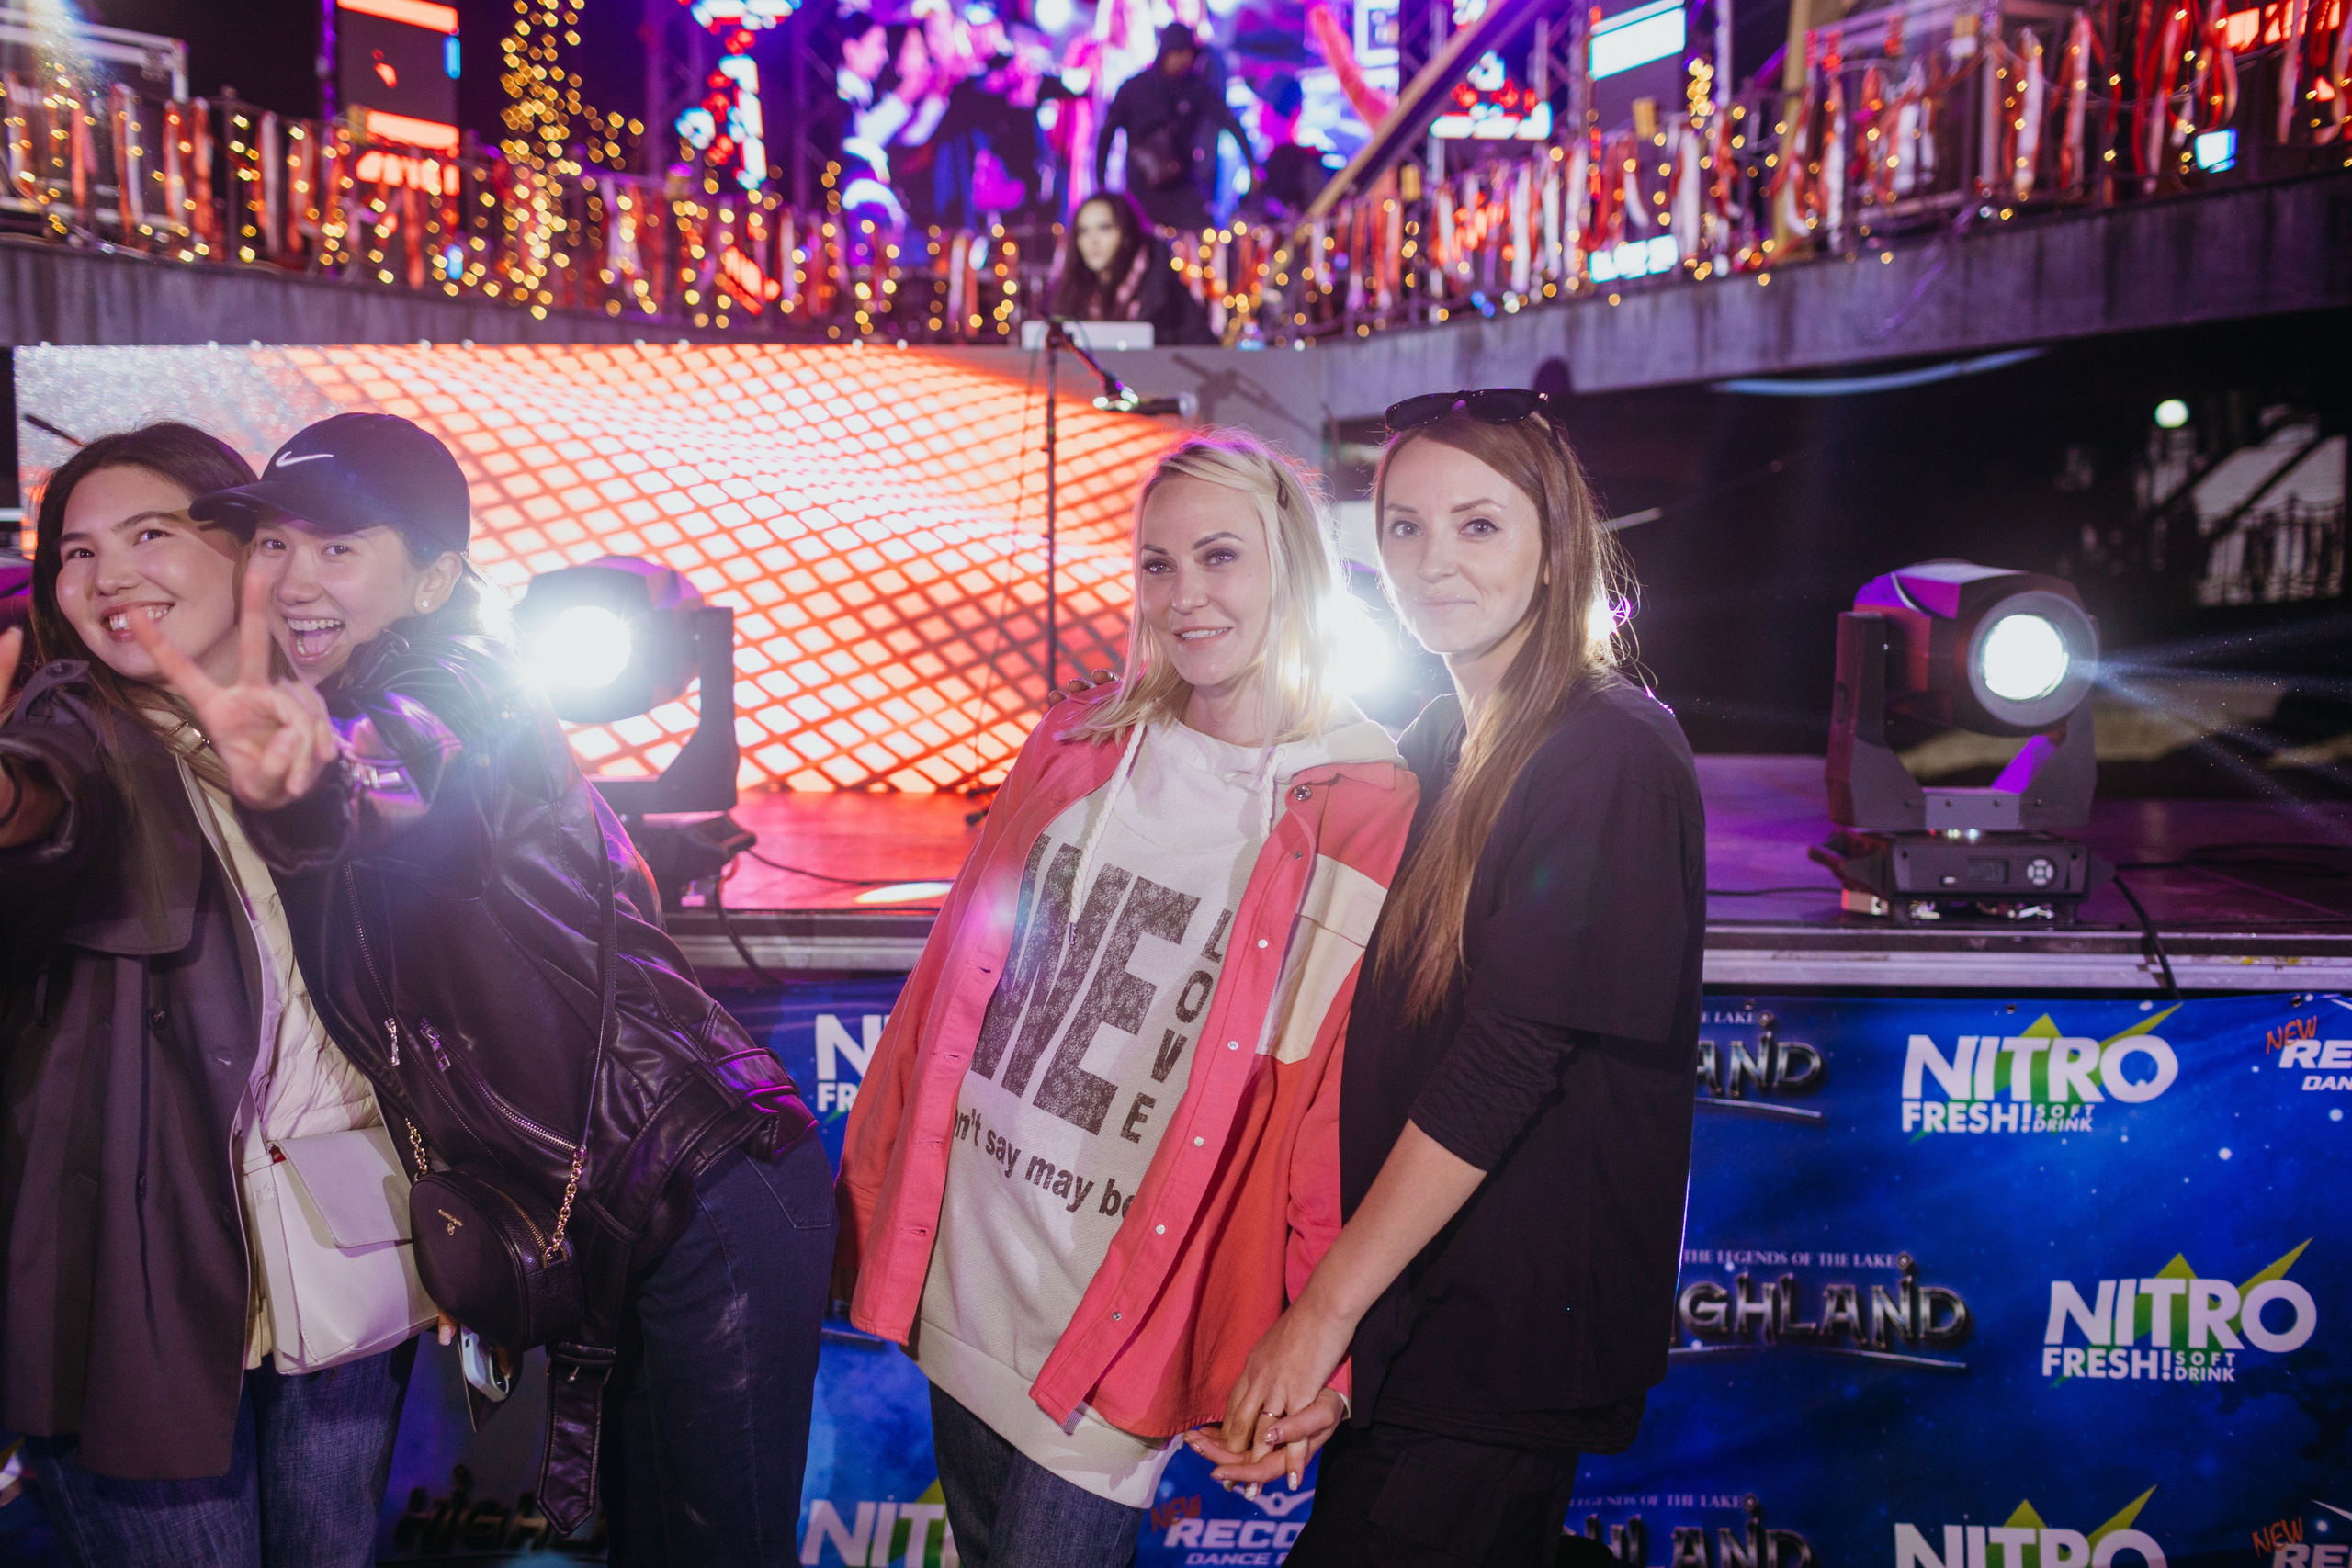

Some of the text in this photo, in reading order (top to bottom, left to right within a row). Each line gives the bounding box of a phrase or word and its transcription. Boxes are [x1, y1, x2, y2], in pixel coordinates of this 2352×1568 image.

[2266, 1014, 2317, 1055] NEW
[1901, 1034, 2179, 1103] NITRO
[1902, 1101, 2032, 1134] FRESH!
[2033, 1117, 2093, 1132] DRINK
[2035, 1104, 2095, 1118] SOFT
[985, 1129, 1021, 1179] say
[1024, 1155, 1095, 1213] may
[1716, 1249, 1788, 1266] LEGENDS
[1791, 1251, 1813, 1267] OF
[1817, 1252, 1849, 1268] THE
[1852, 1252, 1896, 1269] LAKE
[1670, 1272, 1966, 1348] GHLAND
[2043, 1278, 2317, 1353] NITRO
[2041, 1347, 2172, 1380] FRESH!
[2175, 1352, 2235, 1366] SOFT
[2175, 1367, 2235, 1382] DRINK
[1150, 1494, 1202, 1532] NEW
[799, 1499, 961, 1568] NIT
[2251, 1517, 2303, 1559] NEW
[1185, 1552, 1272, 1566] DANCE
